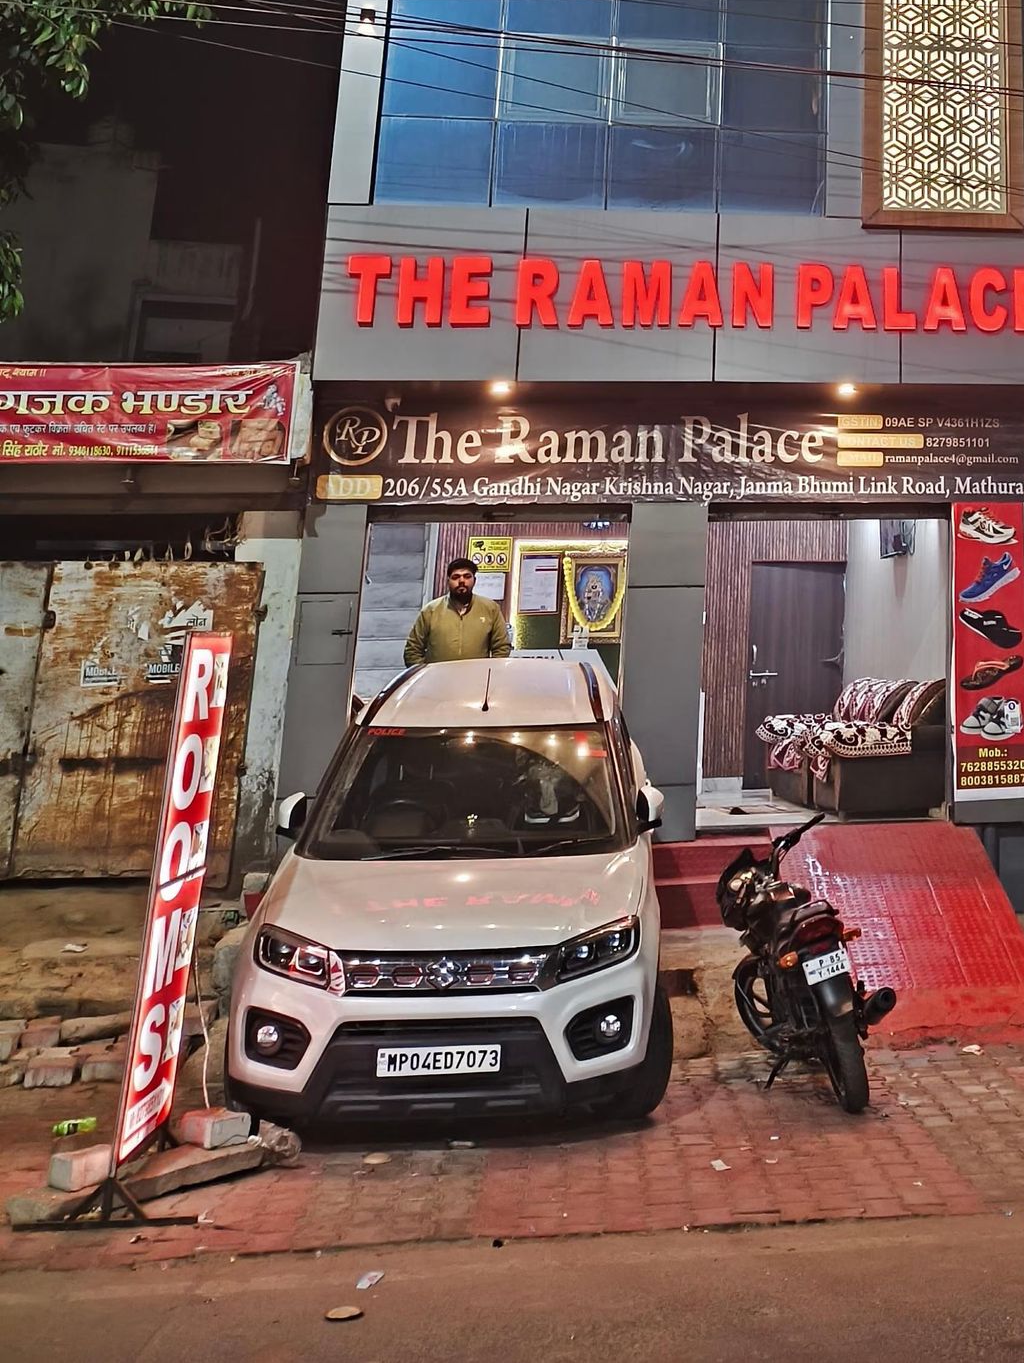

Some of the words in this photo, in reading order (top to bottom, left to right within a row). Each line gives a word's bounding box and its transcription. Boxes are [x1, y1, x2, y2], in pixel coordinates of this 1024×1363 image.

[348, 256, 494, 328] THE
[516, 258, 774, 330] RAMAN
[121, 389, 254, 415] भण्डार
[23, 424, 47, 437] फुटकर
[108, 423, 119, 433] पर
[885, 417, 915, 428] 09AE
[917, 417, 934, 428] SP
[393, 412, 482, 465] The
[494, 415, 665, 465] Raman
[678, 411, 825, 465] Palace
[926, 438, 990, 448] 8279851101
[2, 440, 22, 457] सिंह
[885, 452, 1019, 466] ramanpalace4@gmail.com
[473, 475, 542, 497] Gandhi
[546, 477, 600, 502] Nagar
[604, 476, 674, 496] Krishna
[678, 476, 734, 500] Nagar,
[738, 477, 793, 499] Janma
[798, 472, 854, 496] Bhumi
[858, 475, 898, 495] Link
[901, 475, 950, 498] Road,
[953, 475, 1024, 495] Mathura
[148, 663, 181, 674] MOBILE
[978, 747, 1008, 758] Mob.:
[133, 648, 213, 1093] ROOMS
[386, 1049, 499, 1073] MP04ED7073
